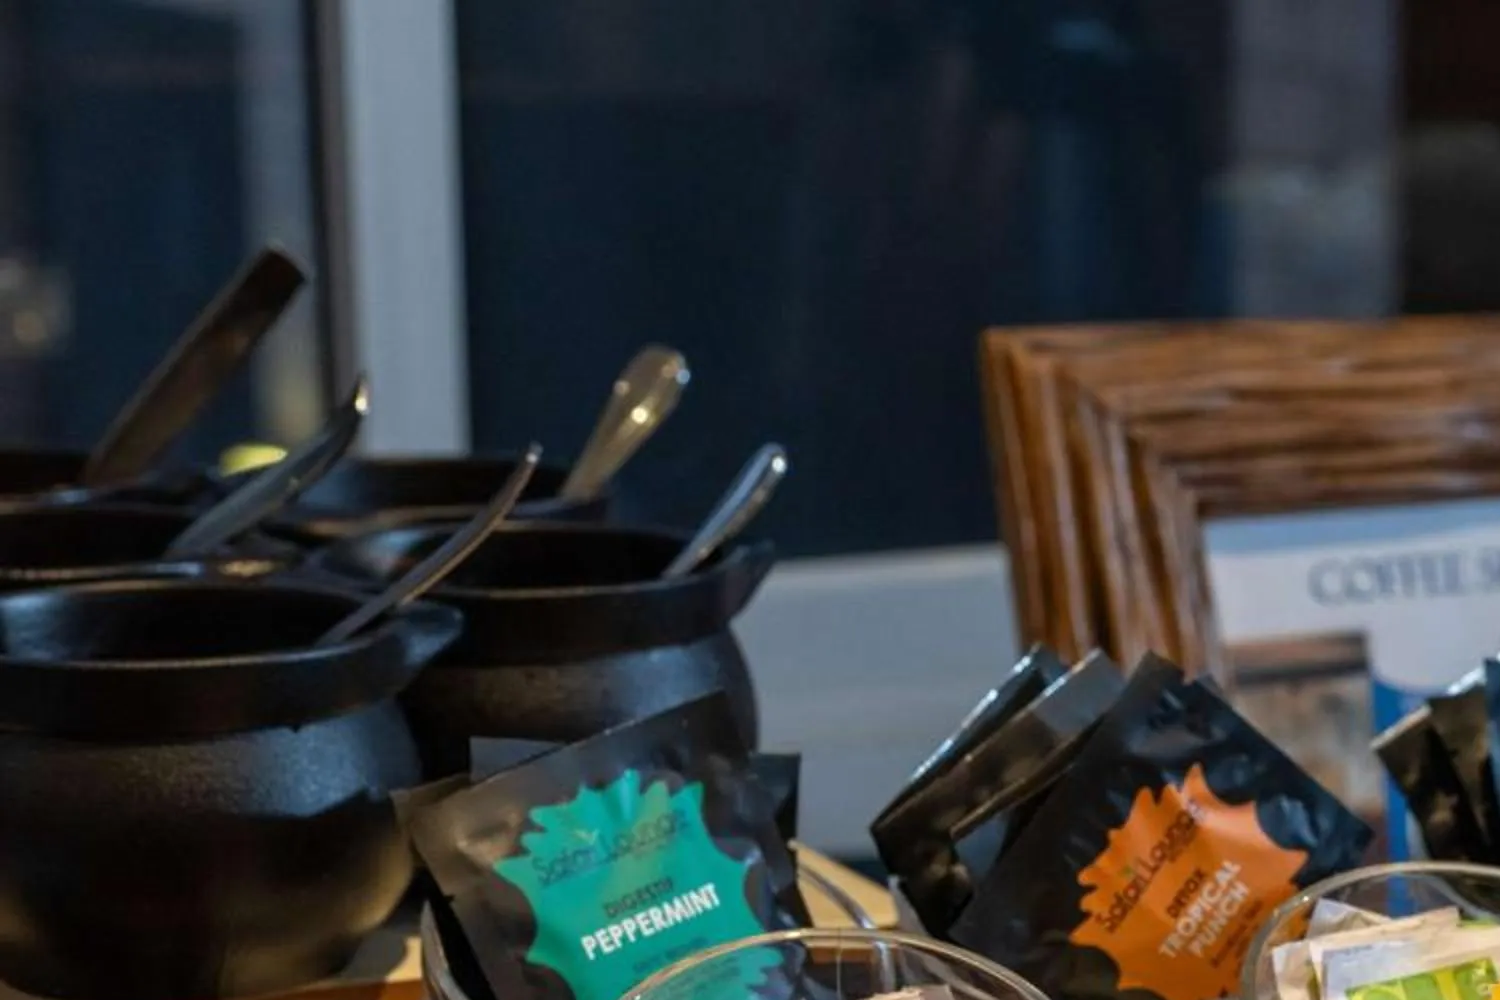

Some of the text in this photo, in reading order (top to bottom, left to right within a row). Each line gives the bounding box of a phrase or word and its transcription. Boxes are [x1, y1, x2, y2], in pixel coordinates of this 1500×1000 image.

[1306, 550, 1463, 604] COFFEE
[580, 882, 721, 961] PEPPERMINT
[1158, 859, 1242, 959] TROPICAL
[1186, 880, 1250, 957] PUNCH
